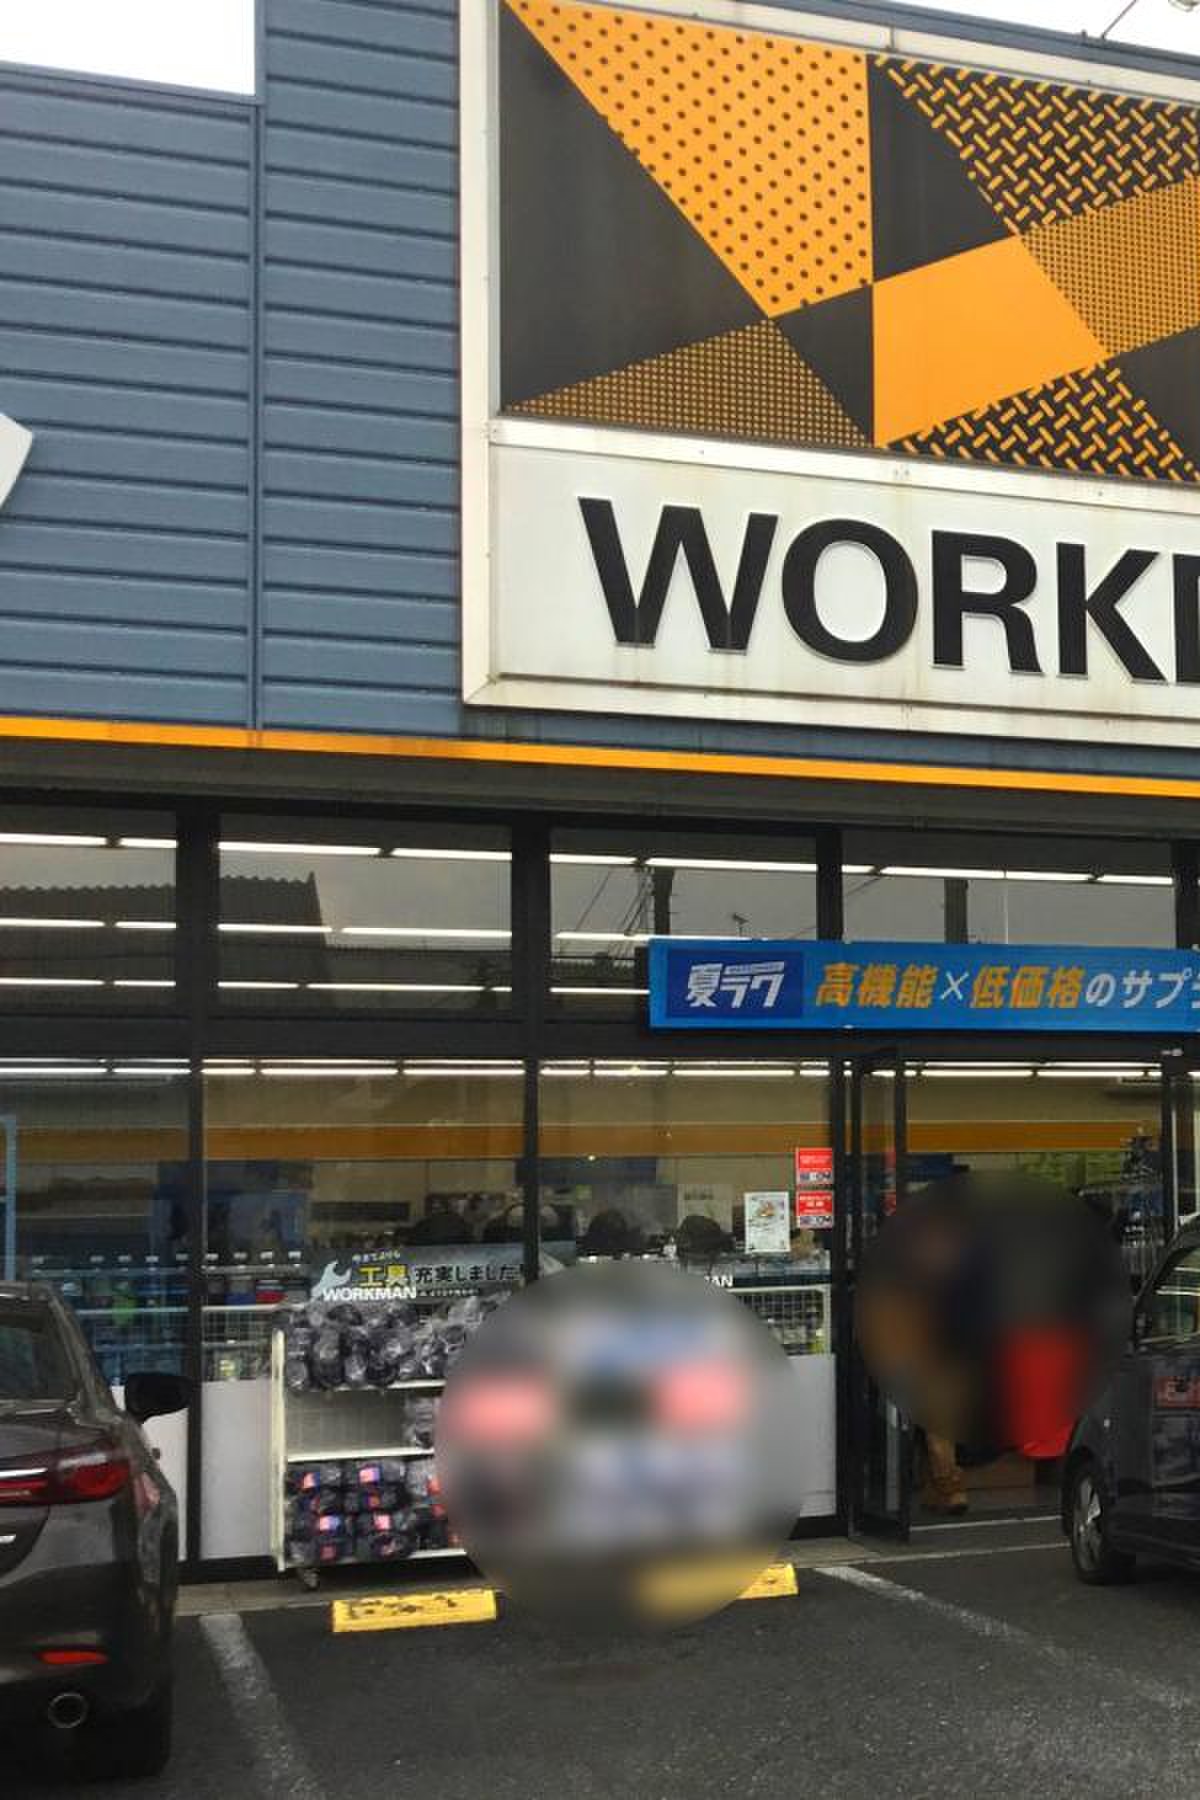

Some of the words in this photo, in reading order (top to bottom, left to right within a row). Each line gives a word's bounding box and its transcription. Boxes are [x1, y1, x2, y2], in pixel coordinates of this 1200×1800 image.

[686, 961, 785, 1008] 夏ラク
[322, 1286, 417, 1301] WORKMAN
